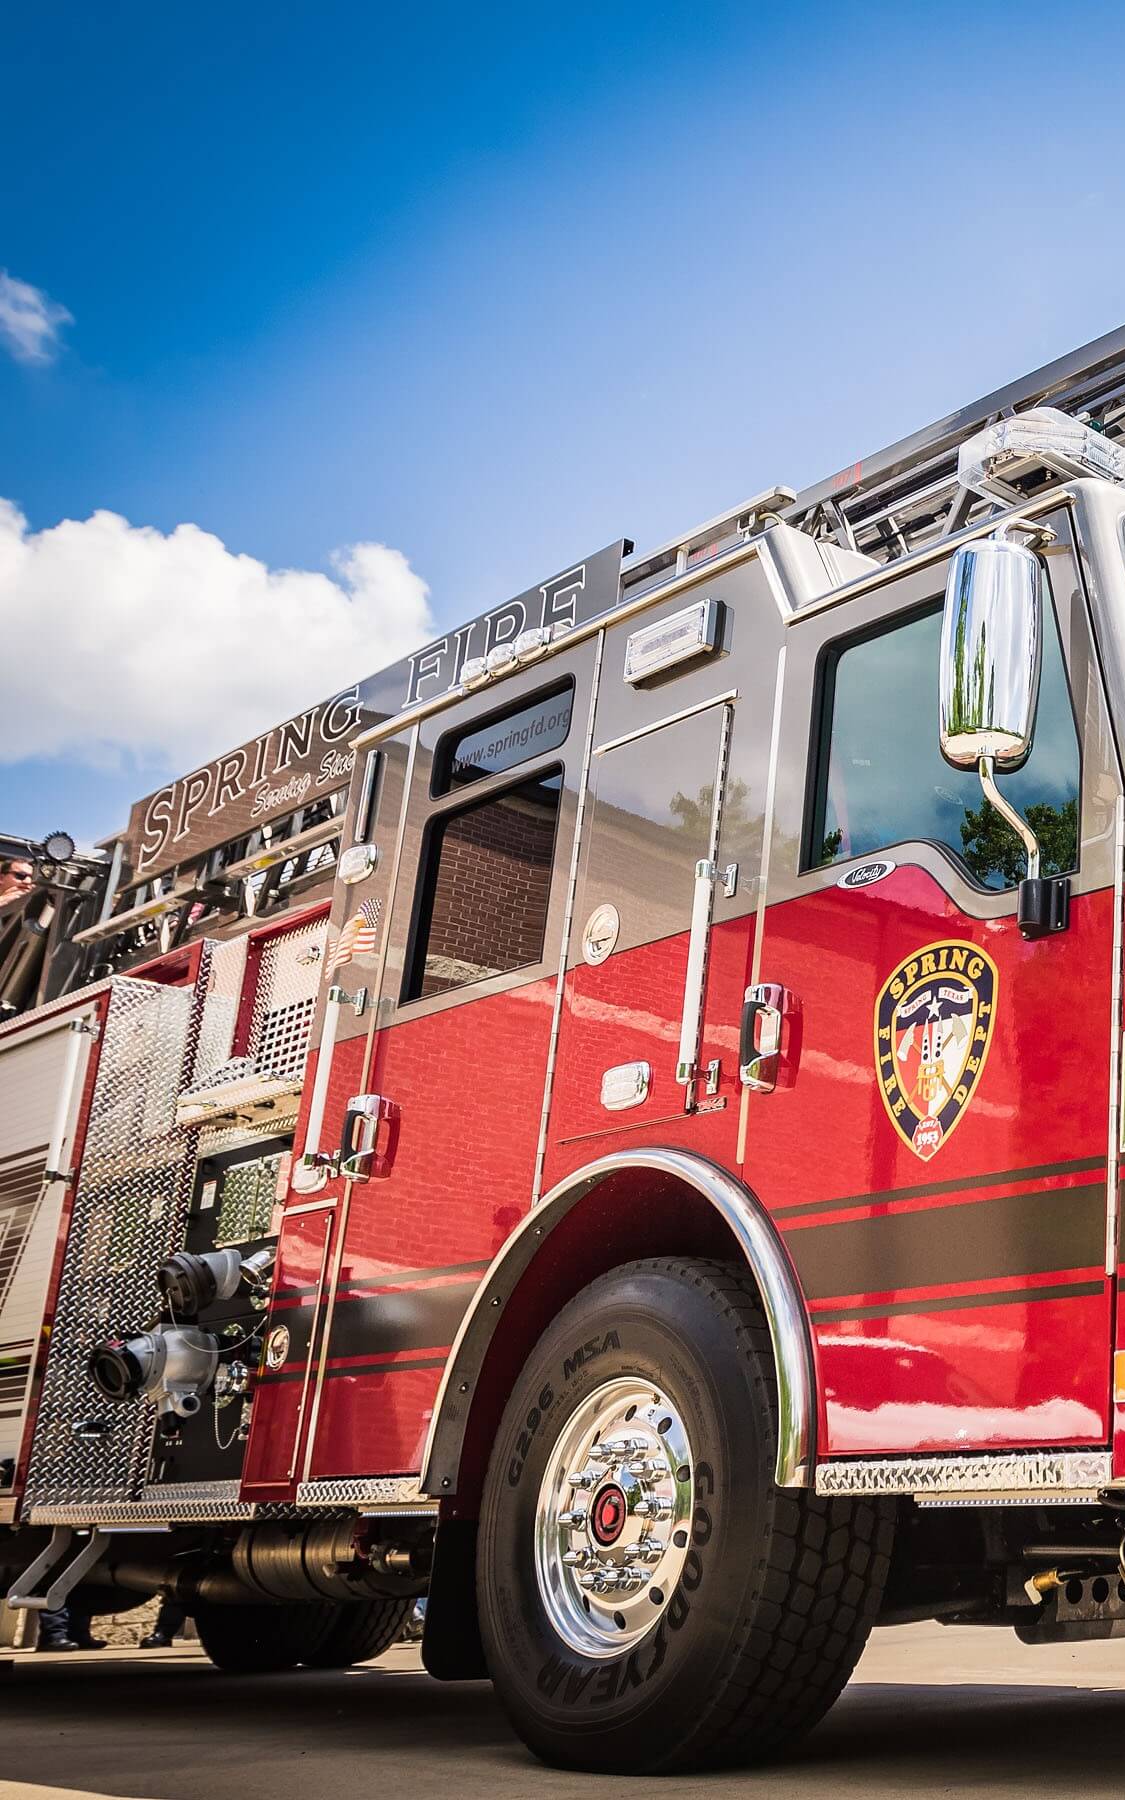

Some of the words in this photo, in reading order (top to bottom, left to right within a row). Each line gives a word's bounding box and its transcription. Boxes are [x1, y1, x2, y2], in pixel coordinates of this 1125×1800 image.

[451, 708, 570, 774] www.springfd.org
[138, 684, 364, 873] SPRING
[250, 772, 312, 818] Serving
[851, 865, 882, 883] Velocity
[889, 948, 985, 1000] SPRING
[943, 989, 964, 1001] TEXAS
[878, 1024, 906, 1118] FIRE
[953, 1000, 991, 1106] DEPT
[916, 1130, 939, 1146] 1953
[508, 1382, 554, 1488] G296
[562, 1330, 622, 1381] MSA
